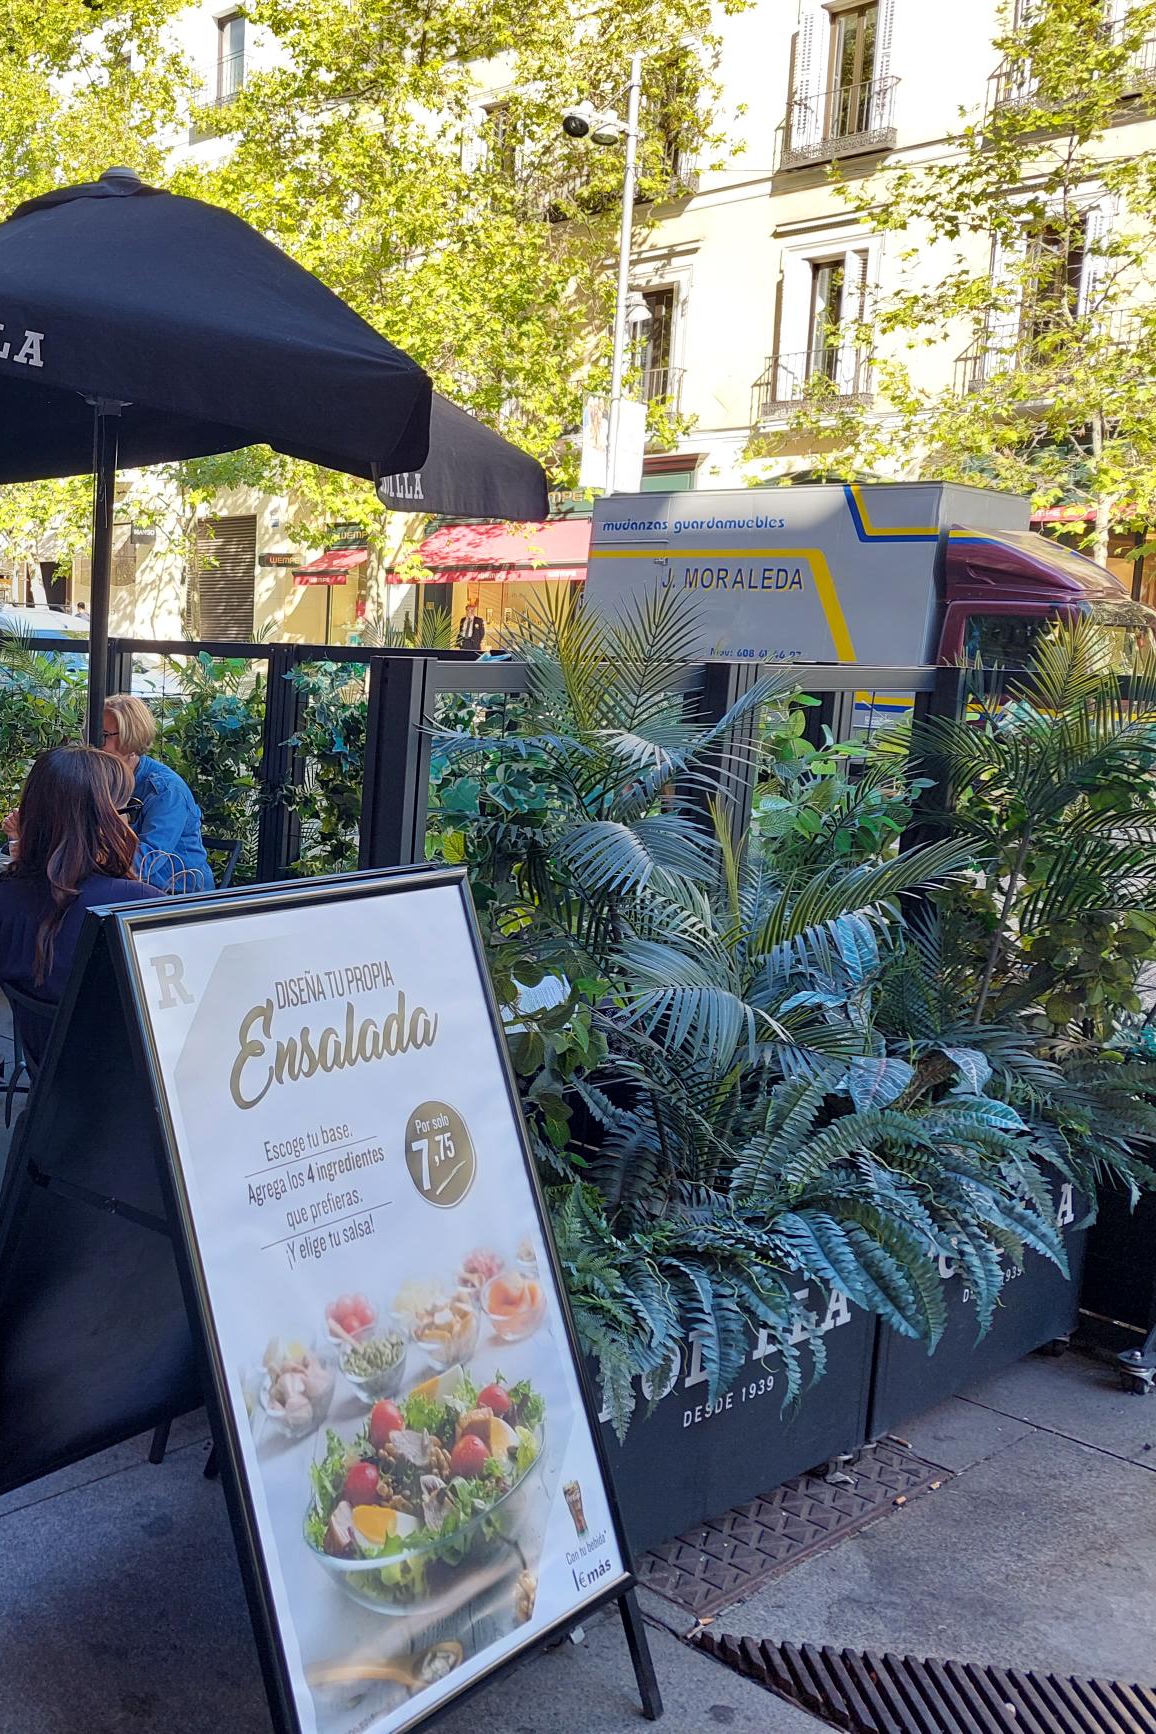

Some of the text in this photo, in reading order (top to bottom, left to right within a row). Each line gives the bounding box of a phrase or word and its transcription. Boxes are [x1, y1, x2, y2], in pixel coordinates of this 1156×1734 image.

[339, 530, 368, 541] WEMP
[603, 516, 785, 533] mudanzas guardamuebles
[662, 567, 804, 591] J. MORALEDA
[737, 648, 755, 658] 608
[149, 953, 194, 1010] R
[275, 960, 395, 1010] DISEÑA TU PROPIA
[229, 990, 438, 1110] Ensalada
[264, 1123, 353, 1162] Escoge tu base.
[415, 1112, 450, 1134] Por solo
[248, 1146, 385, 1206] Agrega los 4 ingredientes
[286, 1188, 364, 1231] que prefieras.
[285, 1213, 375, 1270] ¡Y elige tu salsa!
[683, 1375, 774, 1428] DESDE 1939
[565, 1552, 580, 1565] Con
[579, 1547, 587, 1558] tu
